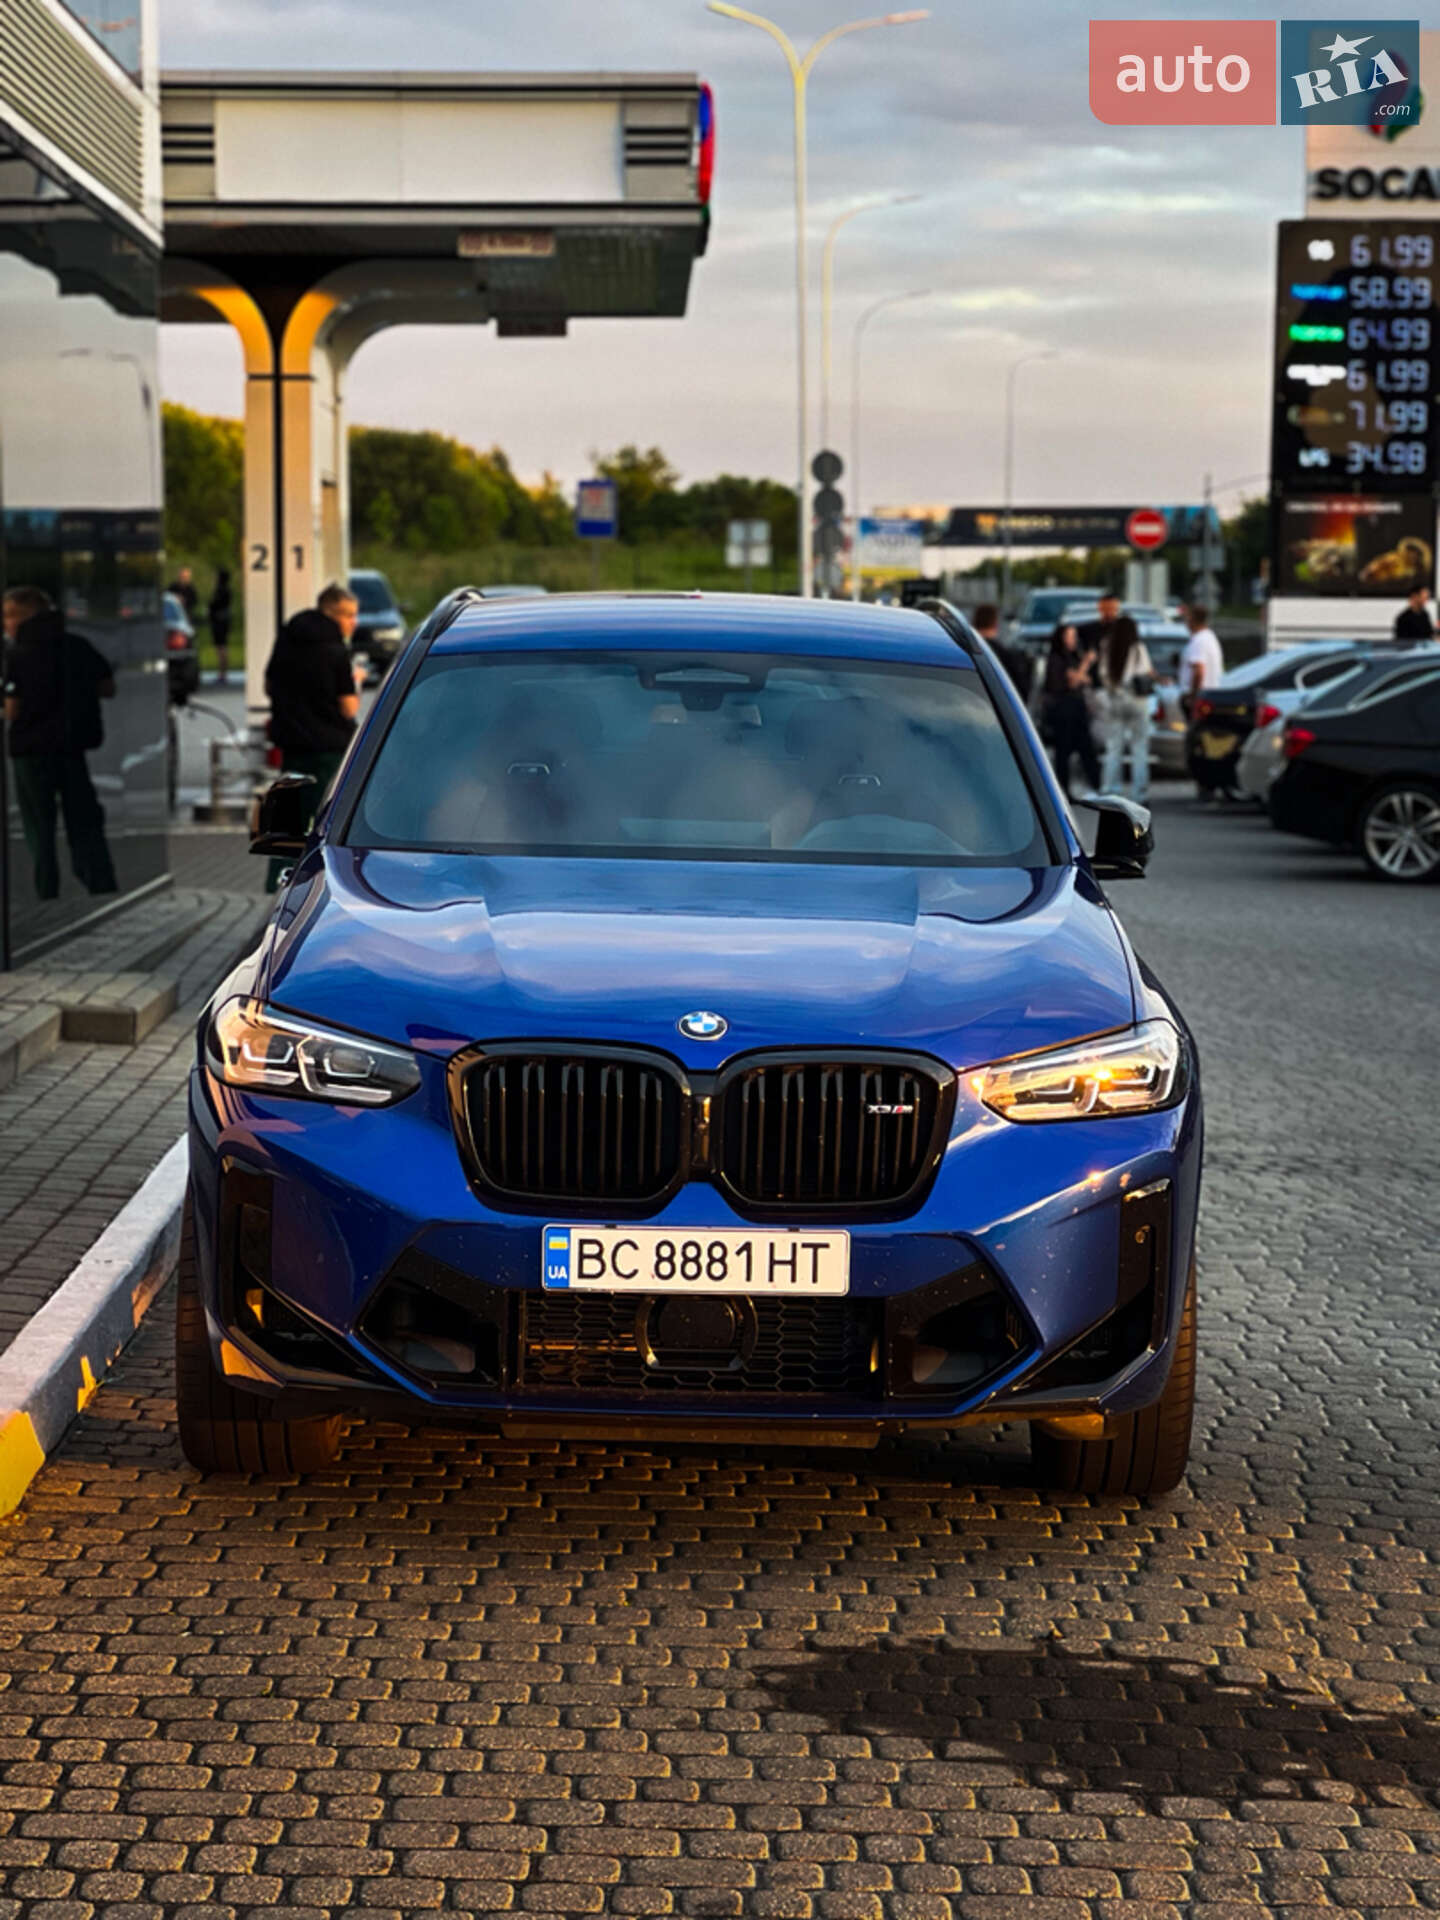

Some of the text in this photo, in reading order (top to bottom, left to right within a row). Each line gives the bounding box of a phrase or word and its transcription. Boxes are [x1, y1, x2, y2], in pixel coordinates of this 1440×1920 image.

[251, 544, 269, 571] 2
[292, 545, 304, 570] 1
[548, 1265, 568, 1280] UA
[577, 1238, 831, 1284] BC 8881 HT
